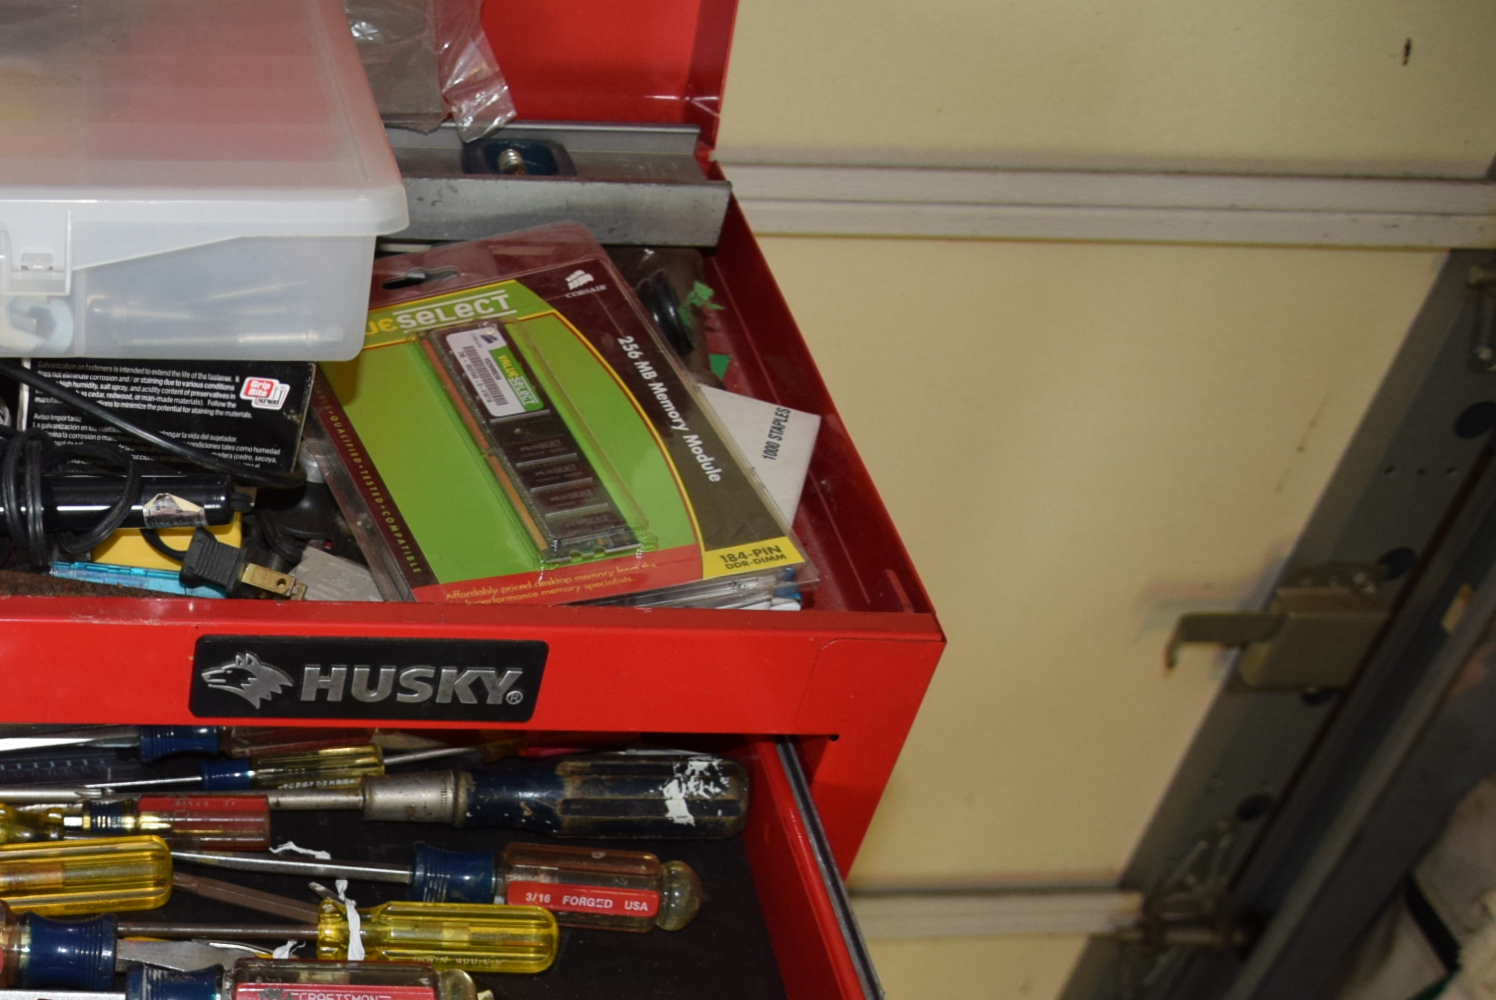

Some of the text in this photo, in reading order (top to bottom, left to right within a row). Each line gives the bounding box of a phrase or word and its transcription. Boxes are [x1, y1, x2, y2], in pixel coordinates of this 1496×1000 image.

[564, 284, 607, 298] CORSAIR
[62, 371, 89, 380] eliminate
[89, 373, 118, 382] corrosion
[118, 374, 129, 383] and
[140, 377, 163, 387] staining
[163, 378, 173, 387] due
[173, 379, 181, 387] to
[182, 380, 204, 389] various
[204, 381, 235, 391] conditions
[85, 362, 113, 373] fasteners
[119, 366, 144, 375] intended
[144, 367, 151, 375] to
[151, 368, 171, 377] extend
[171, 369, 181, 377] the
[181, 370, 191, 379] life
[191, 371, 198, 379] of
[198, 372, 208, 380] the
[208, 373, 232, 382] fastener.
[72, 382, 99, 391] humidity,
[100, 383, 111, 391] salt
[130, 385, 141, 393] and
[141, 386, 161, 396] acidity
[161, 388, 183, 397] content
[183, 389, 191, 397] of
[191, 390, 229, 400] preservatives
[248, 388, 268, 398] Rite
[250, 380, 272, 391] Grip
[120, 401, 146, 410] minimize
[146, 403, 157, 411] the
[157, 404, 182, 413] potential
[182, 406, 191, 414] for
[191, 407, 214, 417] staining
[214, 409, 224, 417] the
[224, 410, 253, 419] materials.
[141, 394, 173, 404] man-made
[207, 397, 226, 407] Follow
[226, 400, 237, 409] the
[616, 335, 723, 483] 256 MB Memory Module
[187, 432, 200, 440] vida
[761, 406, 792, 461] 1000 STAPLES
[221, 443, 236, 451] tales
[235, 445, 253, 453] como
[252, 446, 281, 455] humedad
[359, 469, 384, 505] TESTED
[719, 545, 783, 563] 184-PIN
[724, 553, 788, 570] DDR-DIMM
[445, 585, 499, 600] Affordably
[574, 568, 615, 583] memory
[540, 583, 581, 597] memory
[300, 663, 524, 705] HUSKY
[525, 891, 649, 912] 3/16 FORGED USA
